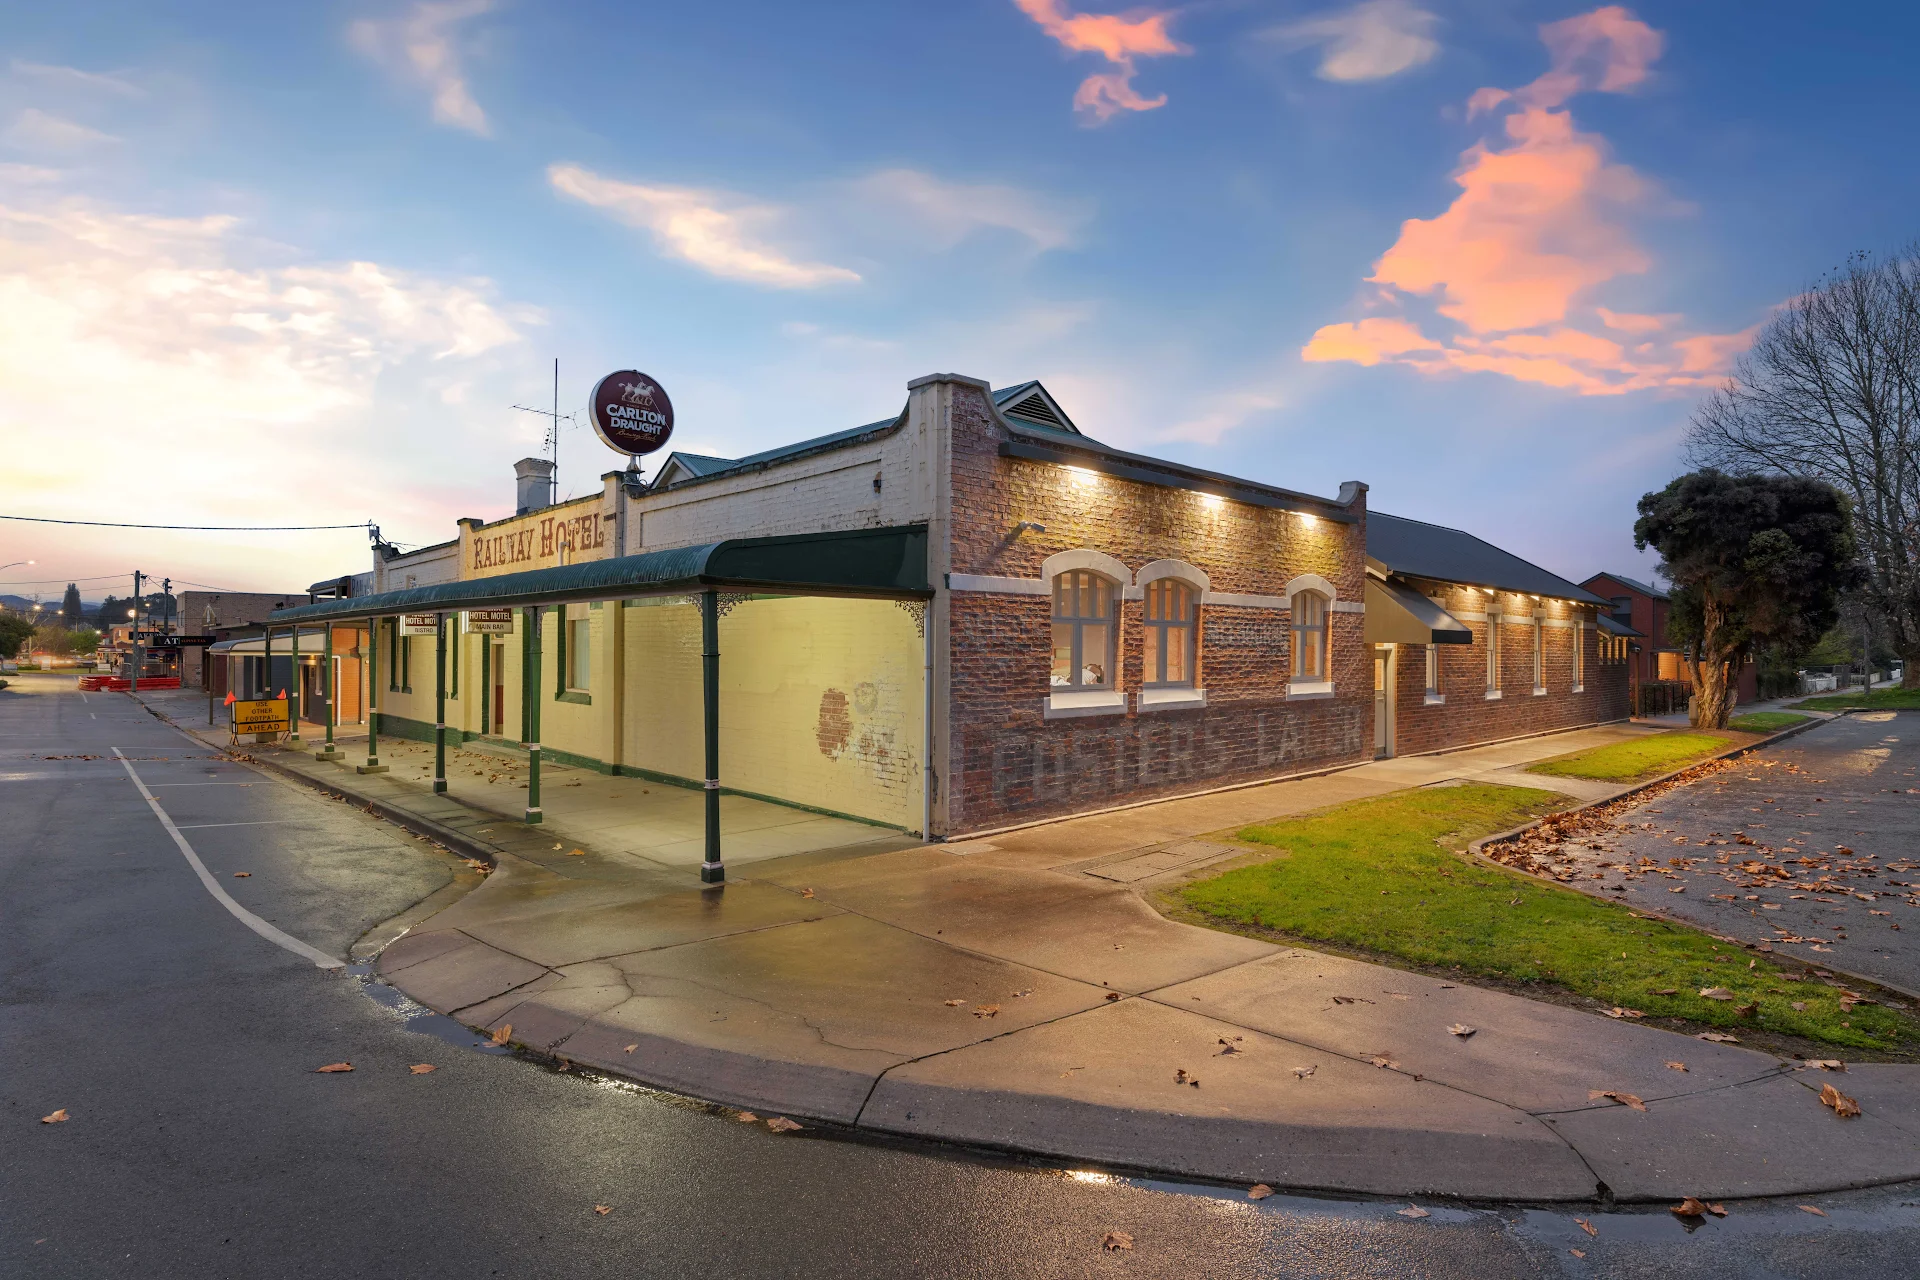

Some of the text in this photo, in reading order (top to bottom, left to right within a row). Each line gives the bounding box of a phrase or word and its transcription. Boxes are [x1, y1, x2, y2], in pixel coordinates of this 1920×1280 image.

[605, 403, 667, 426] CARLTON
[610, 417, 663, 435] DRAUGHT
[473, 512, 605, 569] RAILWAY HOTEL
[469, 611, 511, 620] HOTEL MOTEL
[405, 617, 436, 625] HOTEL MOT
[164, 637, 179, 645] AT
[247, 724, 280, 732] AHEAD
